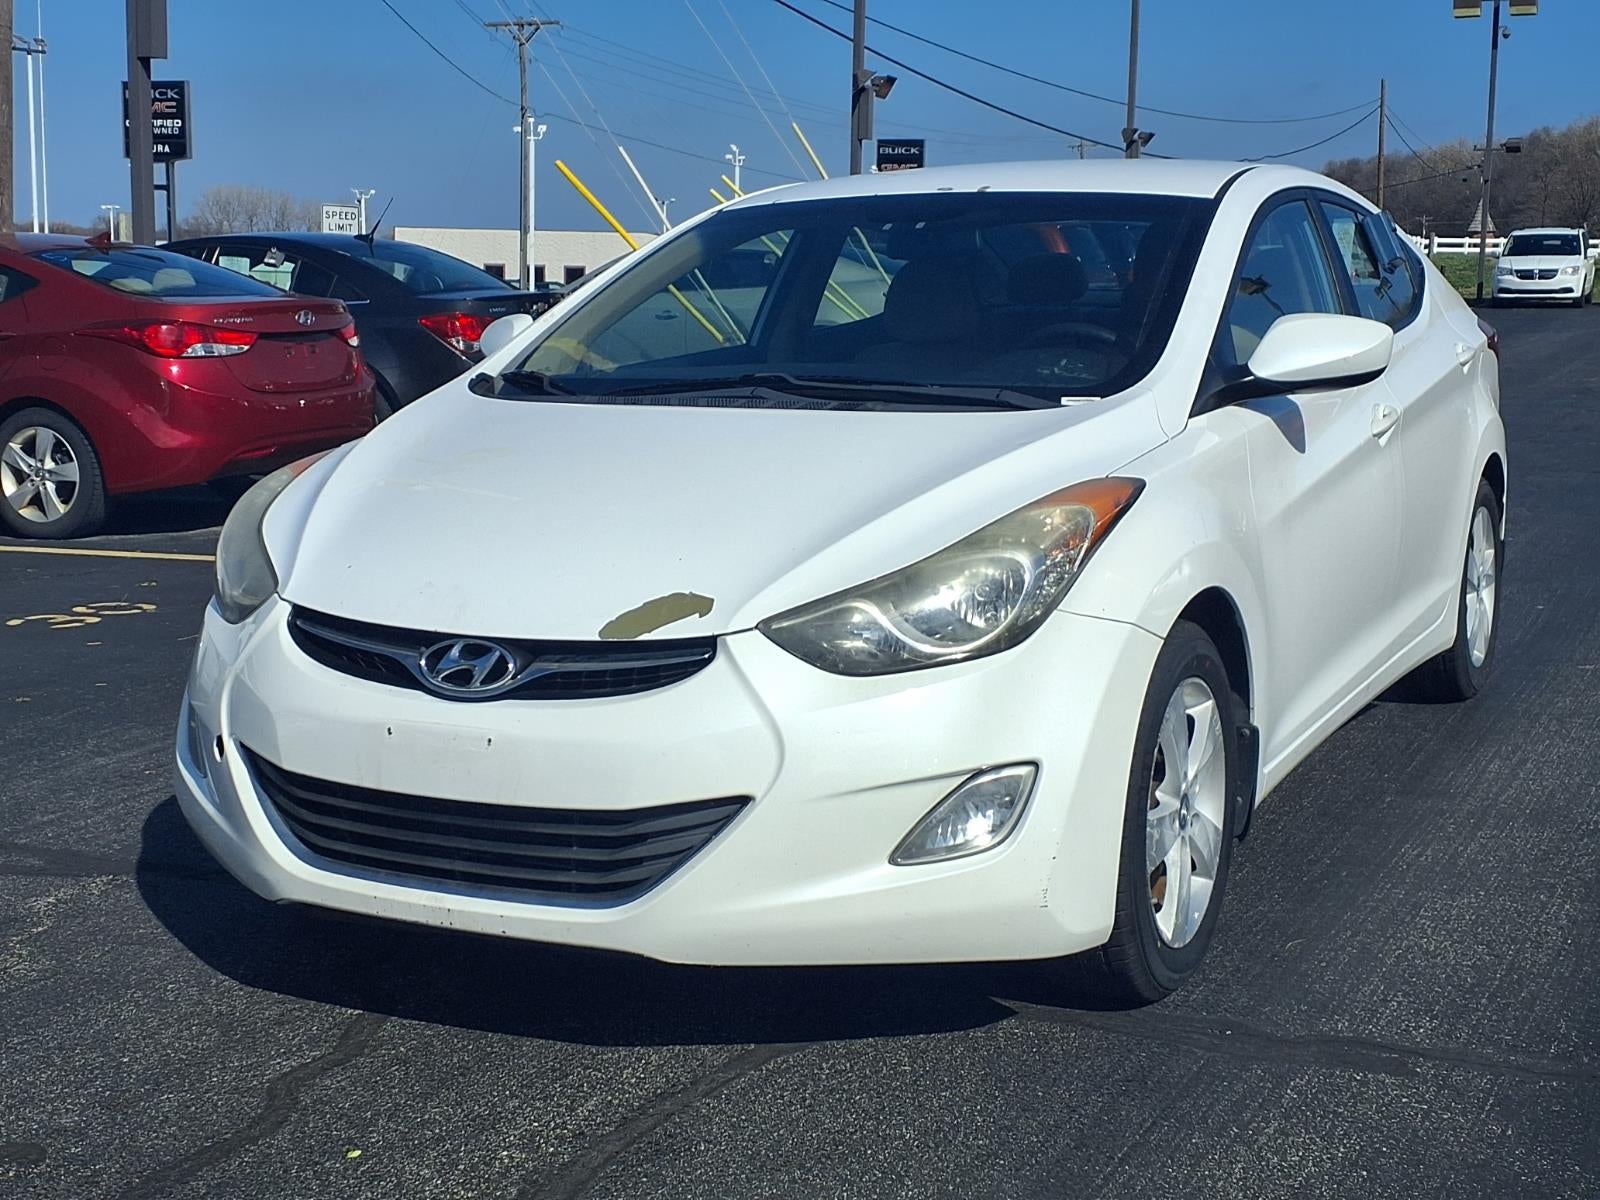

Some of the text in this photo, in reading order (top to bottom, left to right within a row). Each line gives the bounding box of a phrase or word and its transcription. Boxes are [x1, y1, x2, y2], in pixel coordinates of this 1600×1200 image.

[879, 146, 920, 154] BUICK
[324, 210, 357, 221] SPEED
[328, 223, 353, 232] LIMIT
